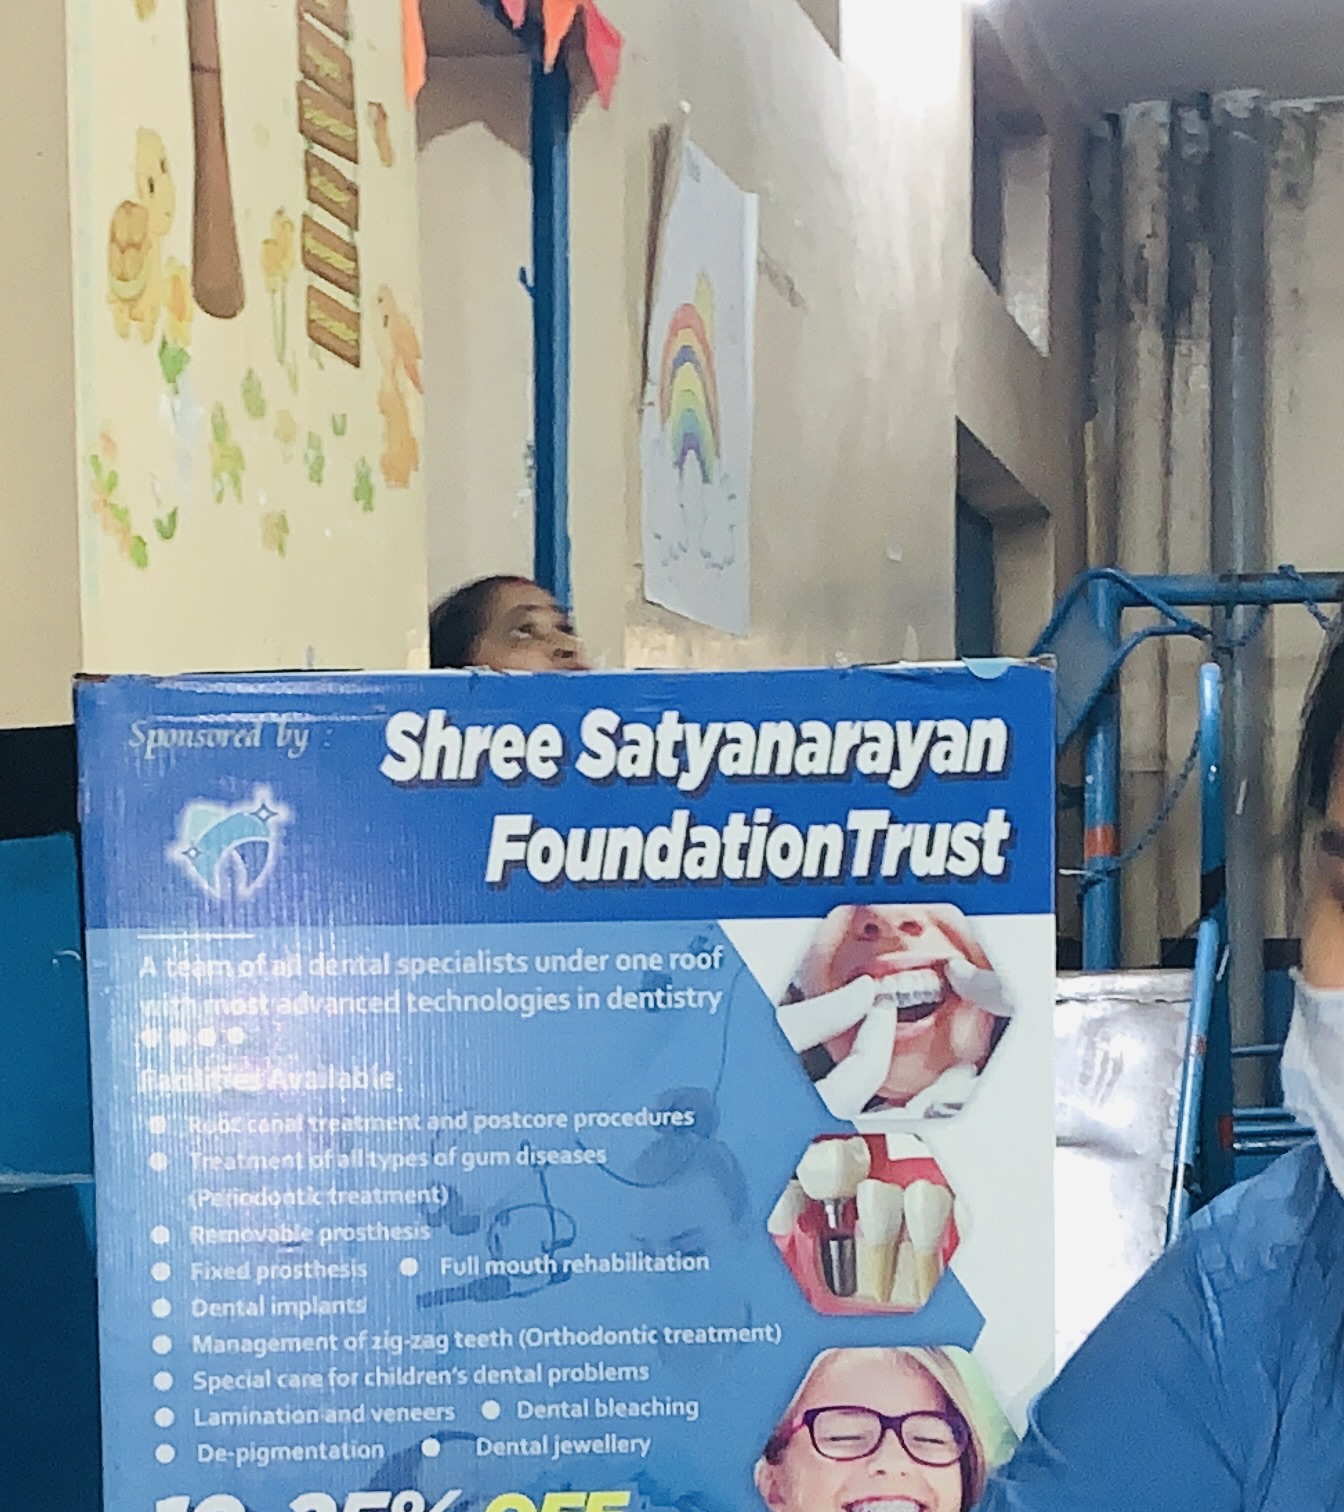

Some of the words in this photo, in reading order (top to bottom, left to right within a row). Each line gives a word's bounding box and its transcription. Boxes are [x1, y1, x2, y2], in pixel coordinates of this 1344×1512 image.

[128, 720, 259, 760] Sponsored
[276, 720, 309, 760] by
[380, 709, 564, 783] Shree
[575, 707, 1009, 792] Satyanarayan
[140, 955, 156, 978] A
[166, 956, 231, 979] team
[235, 953, 267, 977] of
[309, 952, 390, 977] dental
[396, 949, 529, 981] specialists
[535, 947, 609, 973] under
[616, 952, 663, 972] one
[670, 945, 724, 971] roof
[276, 989, 401, 1017] advanced
[407, 987, 570, 1018] technologies
[577, 985, 600, 1010] in
[607, 983, 723, 1015] dentistry
[310, 1112, 422, 1134] treatment
[427, 1111, 467, 1131] and
[473, 1110, 568, 1134] postcore
[574, 1107, 695, 1132] procedures
[190, 1151, 303, 1172] Treatment
[309, 1150, 333, 1170] of
[370, 1150, 429, 1173] types
[433, 1147, 457, 1168] of
[461, 1151, 510, 1172] gum
[516, 1145, 607, 1166] diseases
[328, 1183, 449, 1207] treatment)
[189, 1223, 314, 1244] Removable
[319, 1221, 432, 1247] prosthesis
[190, 1261, 251, 1282] Fixed
[256, 1258, 369, 1286] prosthesis
[440, 1254, 479, 1277] Full
[485, 1254, 557, 1276] mouth
[563, 1250, 711, 1274] rehabilitation
[191, 1295, 265, 1318] Dental
[271, 1296, 368, 1321] implants
[192, 1333, 338, 1359] Management
[344, 1329, 368, 1351] of
[372, 1331, 449, 1355] zig-zag
[454, 1326, 514, 1349] teeth
[519, 1323, 659, 1350] (Orthodontic
[664, 1322, 783, 1346] treatment)
[193, 1369, 271, 1396] Special
[277, 1372, 323, 1389] care
[328, 1367, 358, 1389] for
[473, 1362, 543, 1385] dental
[548, 1360, 650, 1388] problems
[194, 1404, 319, 1428] Lamination
[324, 1403, 365, 1425] and
[371, 1405, 456, 1424] veneers
[517, 1397, 589, 1420] Dental
[594, 1395, 700, 1423] bleaching
[197, 1440, 385, 1468] De-pigmentation
[476, 1435, 549, 1458] Dental
[551, 1432, 652, 1461] jewellery
